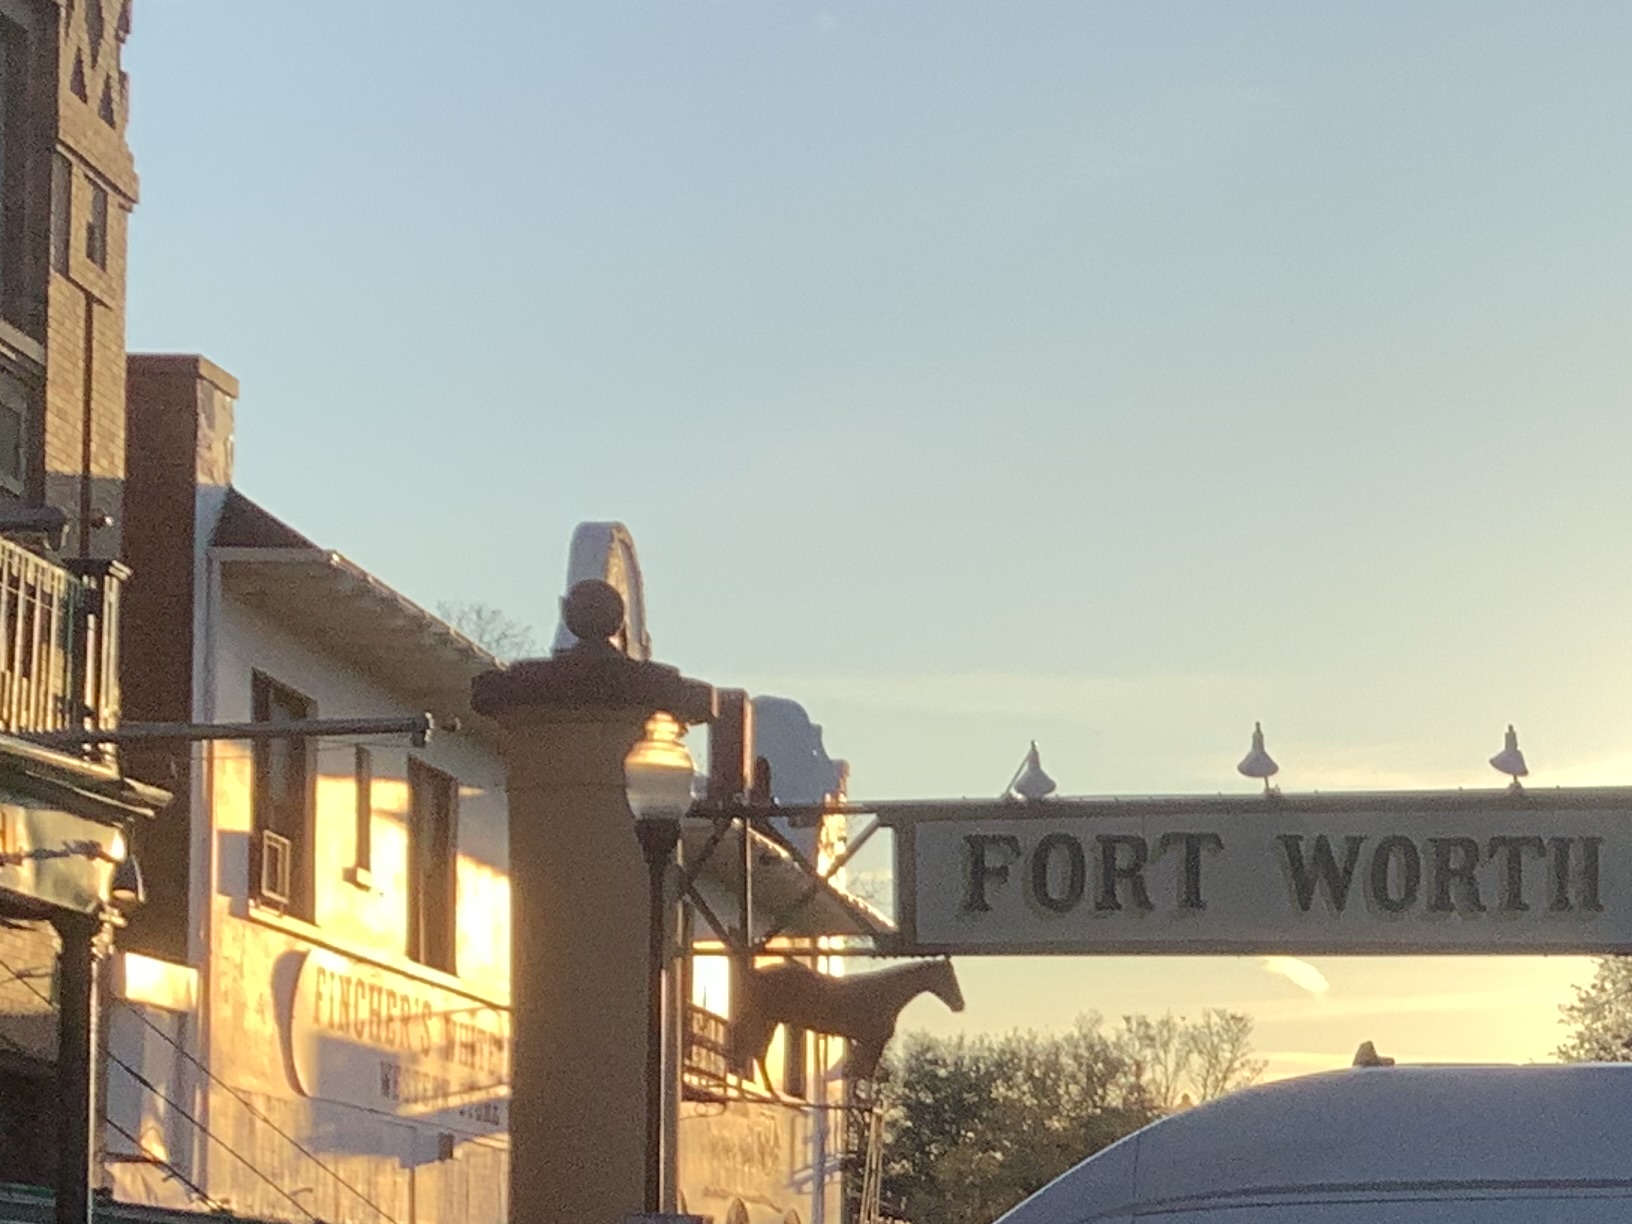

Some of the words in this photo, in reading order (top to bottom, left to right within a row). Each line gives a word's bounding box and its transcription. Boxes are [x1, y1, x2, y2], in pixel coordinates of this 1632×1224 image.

[958, 832, 1225, 920] FORT
[1277, 833, 1606, 920] WORTH
[313, 966, 434, 1058] FINCHER'S
